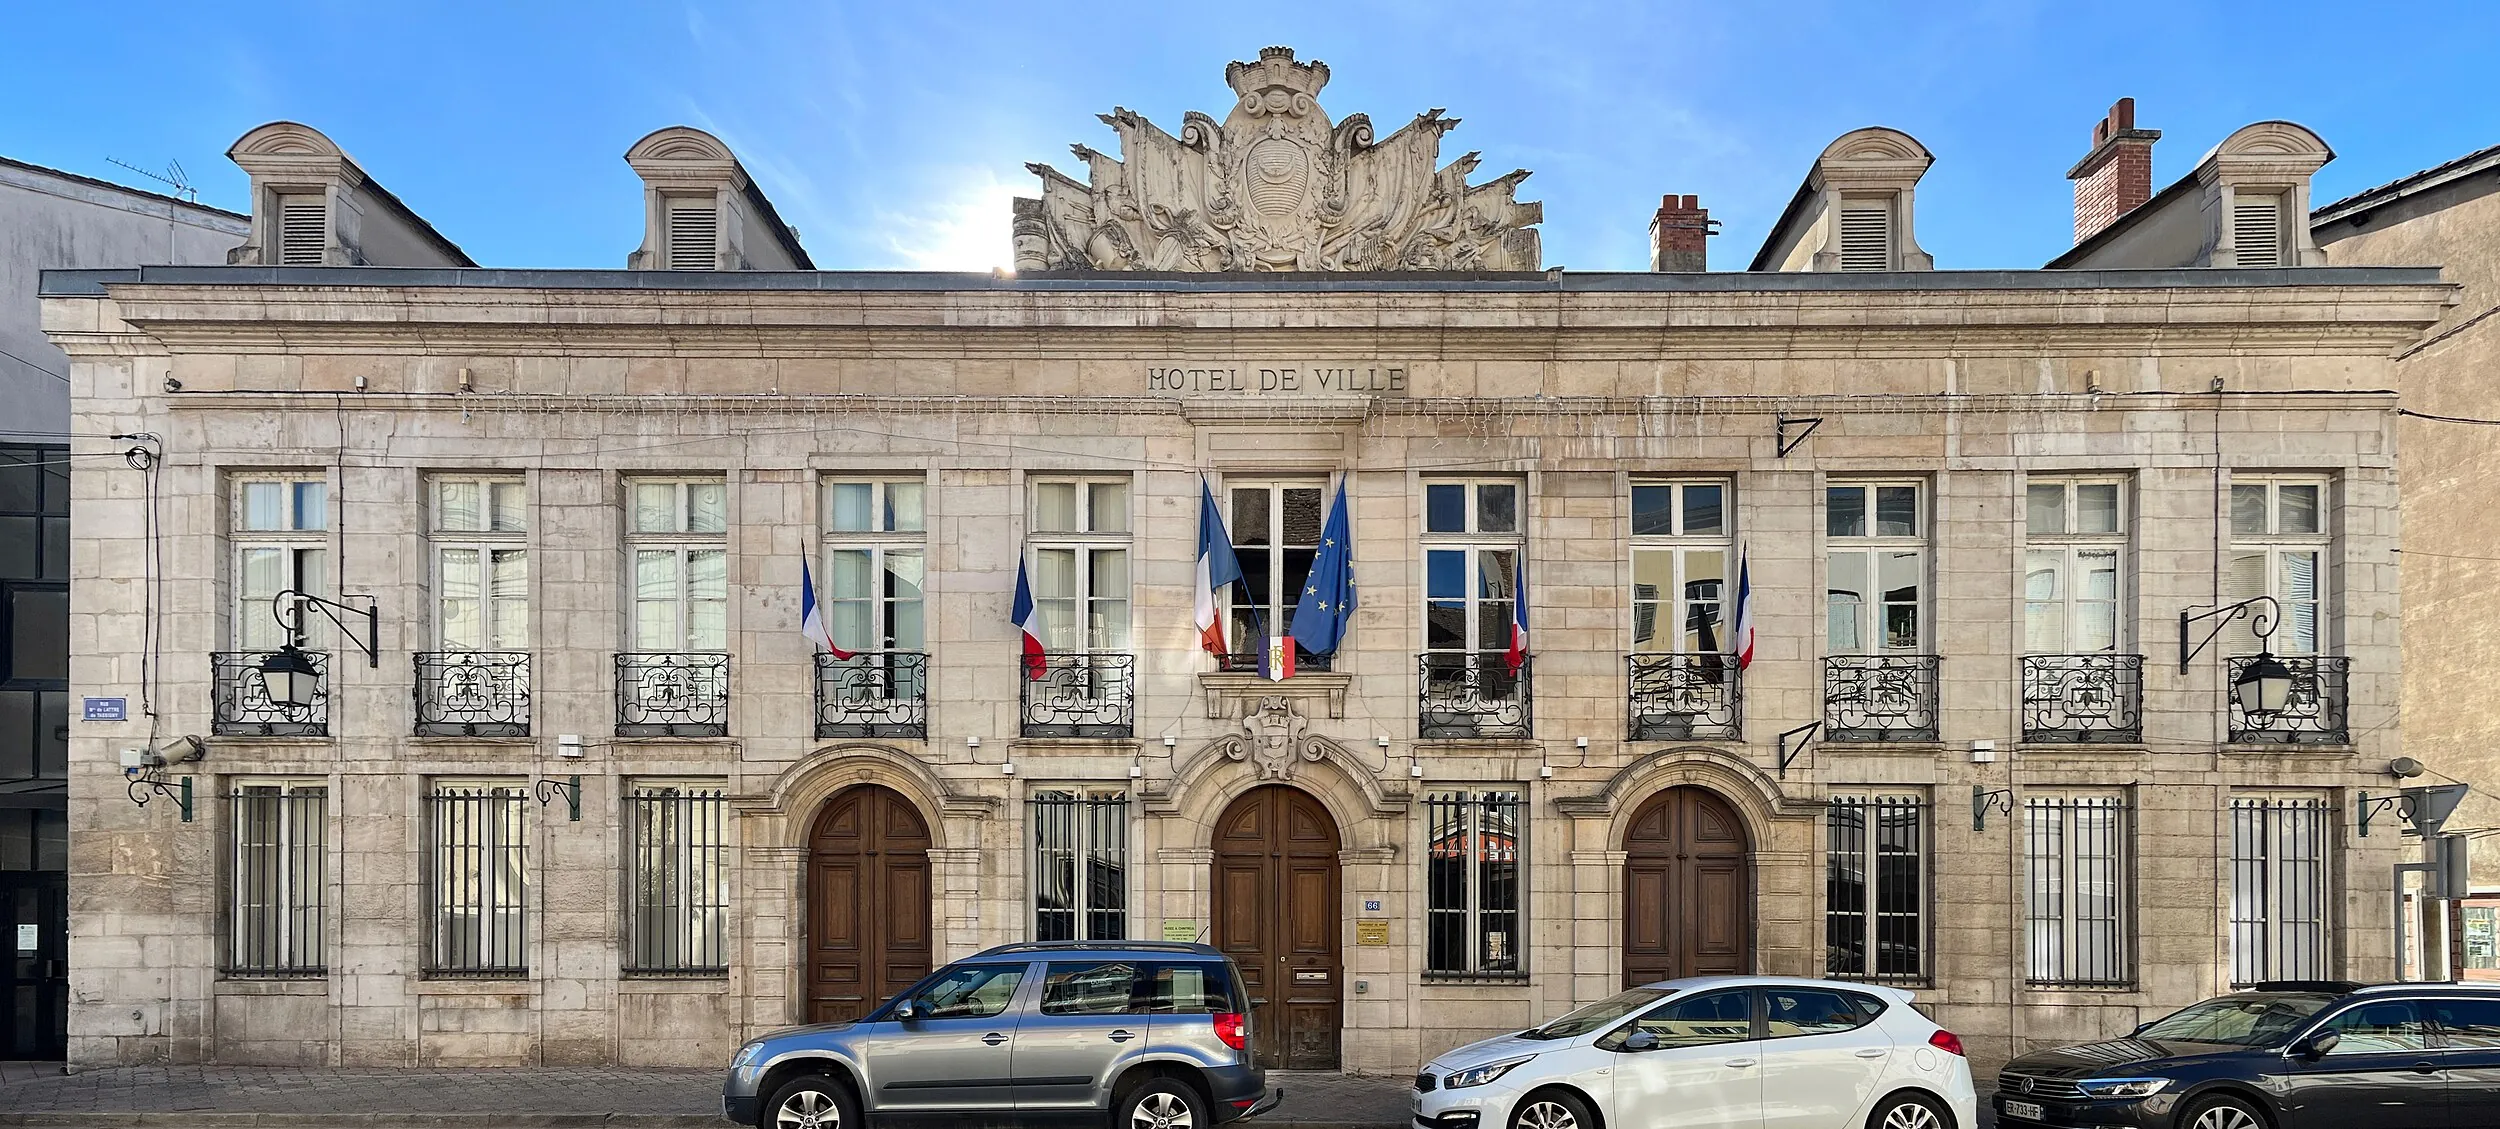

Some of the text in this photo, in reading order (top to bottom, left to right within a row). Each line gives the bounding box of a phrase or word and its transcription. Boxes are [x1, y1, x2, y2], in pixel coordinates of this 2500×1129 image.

[1147, 367, 1406, 392] HOTEL DE VILLE
